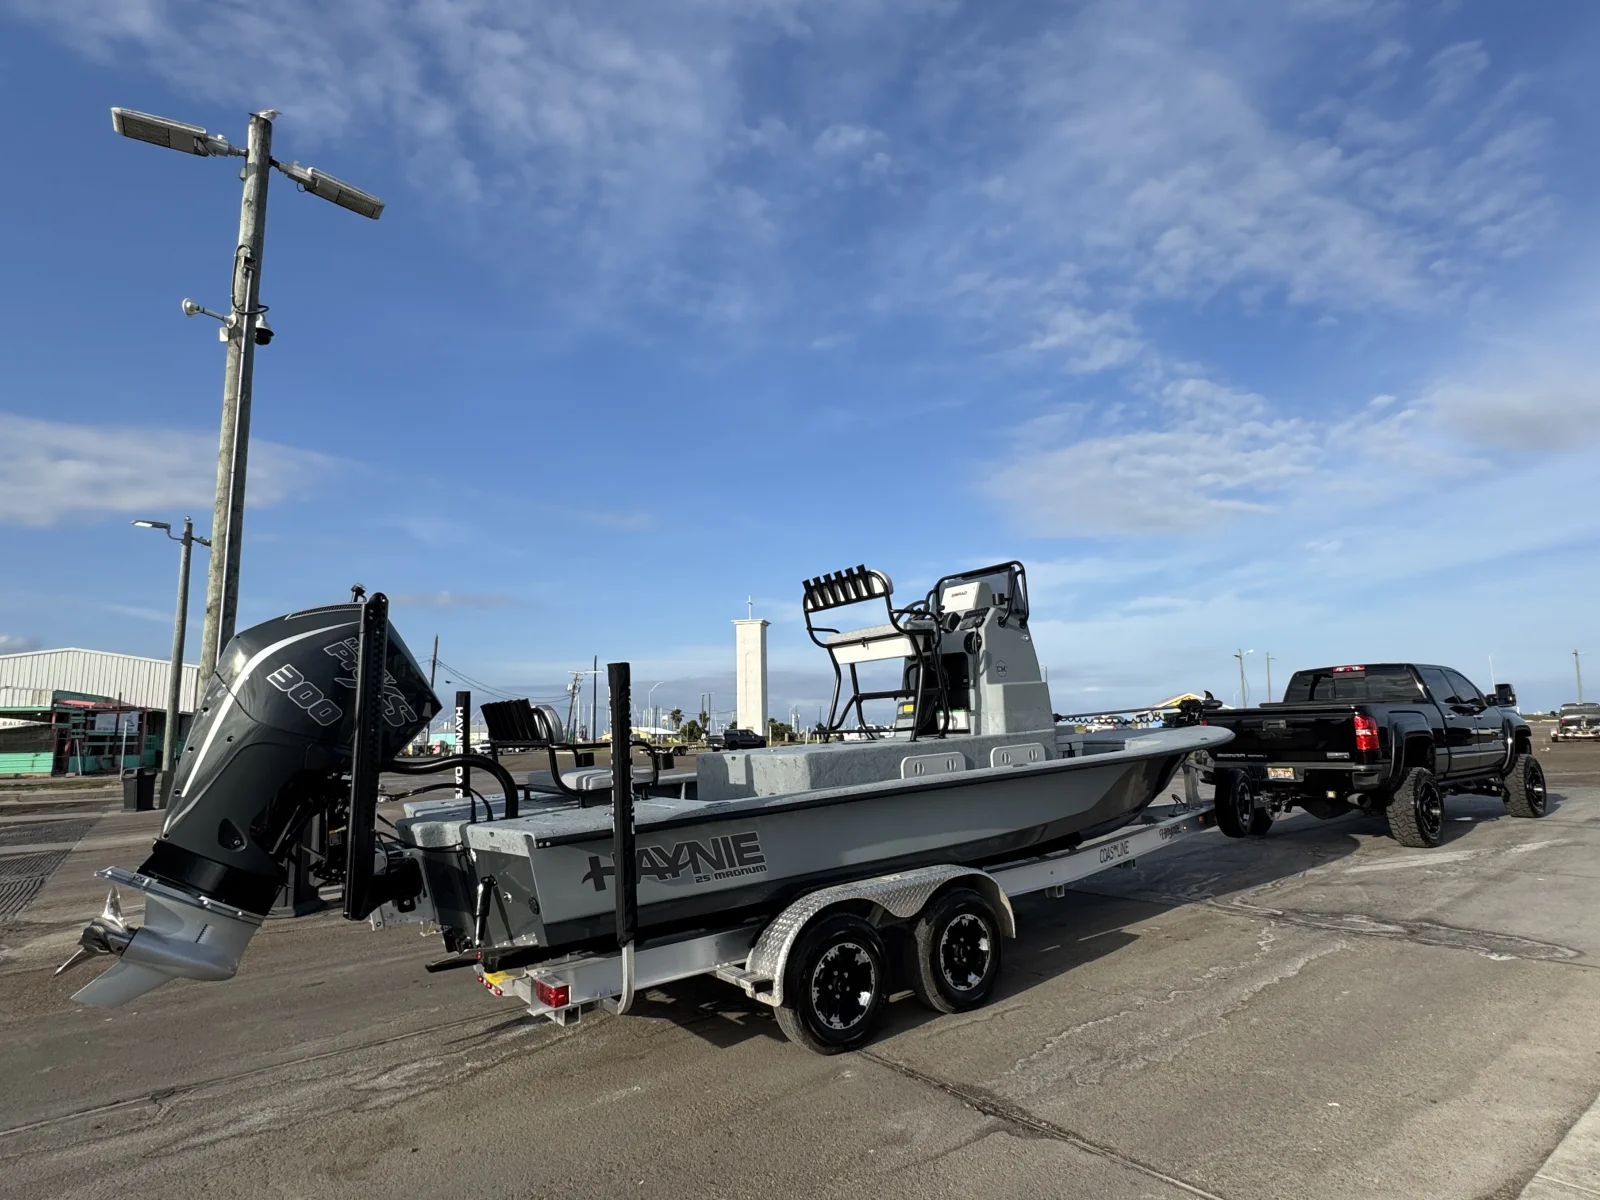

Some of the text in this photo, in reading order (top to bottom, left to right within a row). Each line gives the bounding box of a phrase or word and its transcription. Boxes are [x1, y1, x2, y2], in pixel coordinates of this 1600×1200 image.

[266, 663, 343, 726] 300
[455, 706, 464, 754] HAYNIE
[695, 864, 768, 884] 25 MAGNUM
